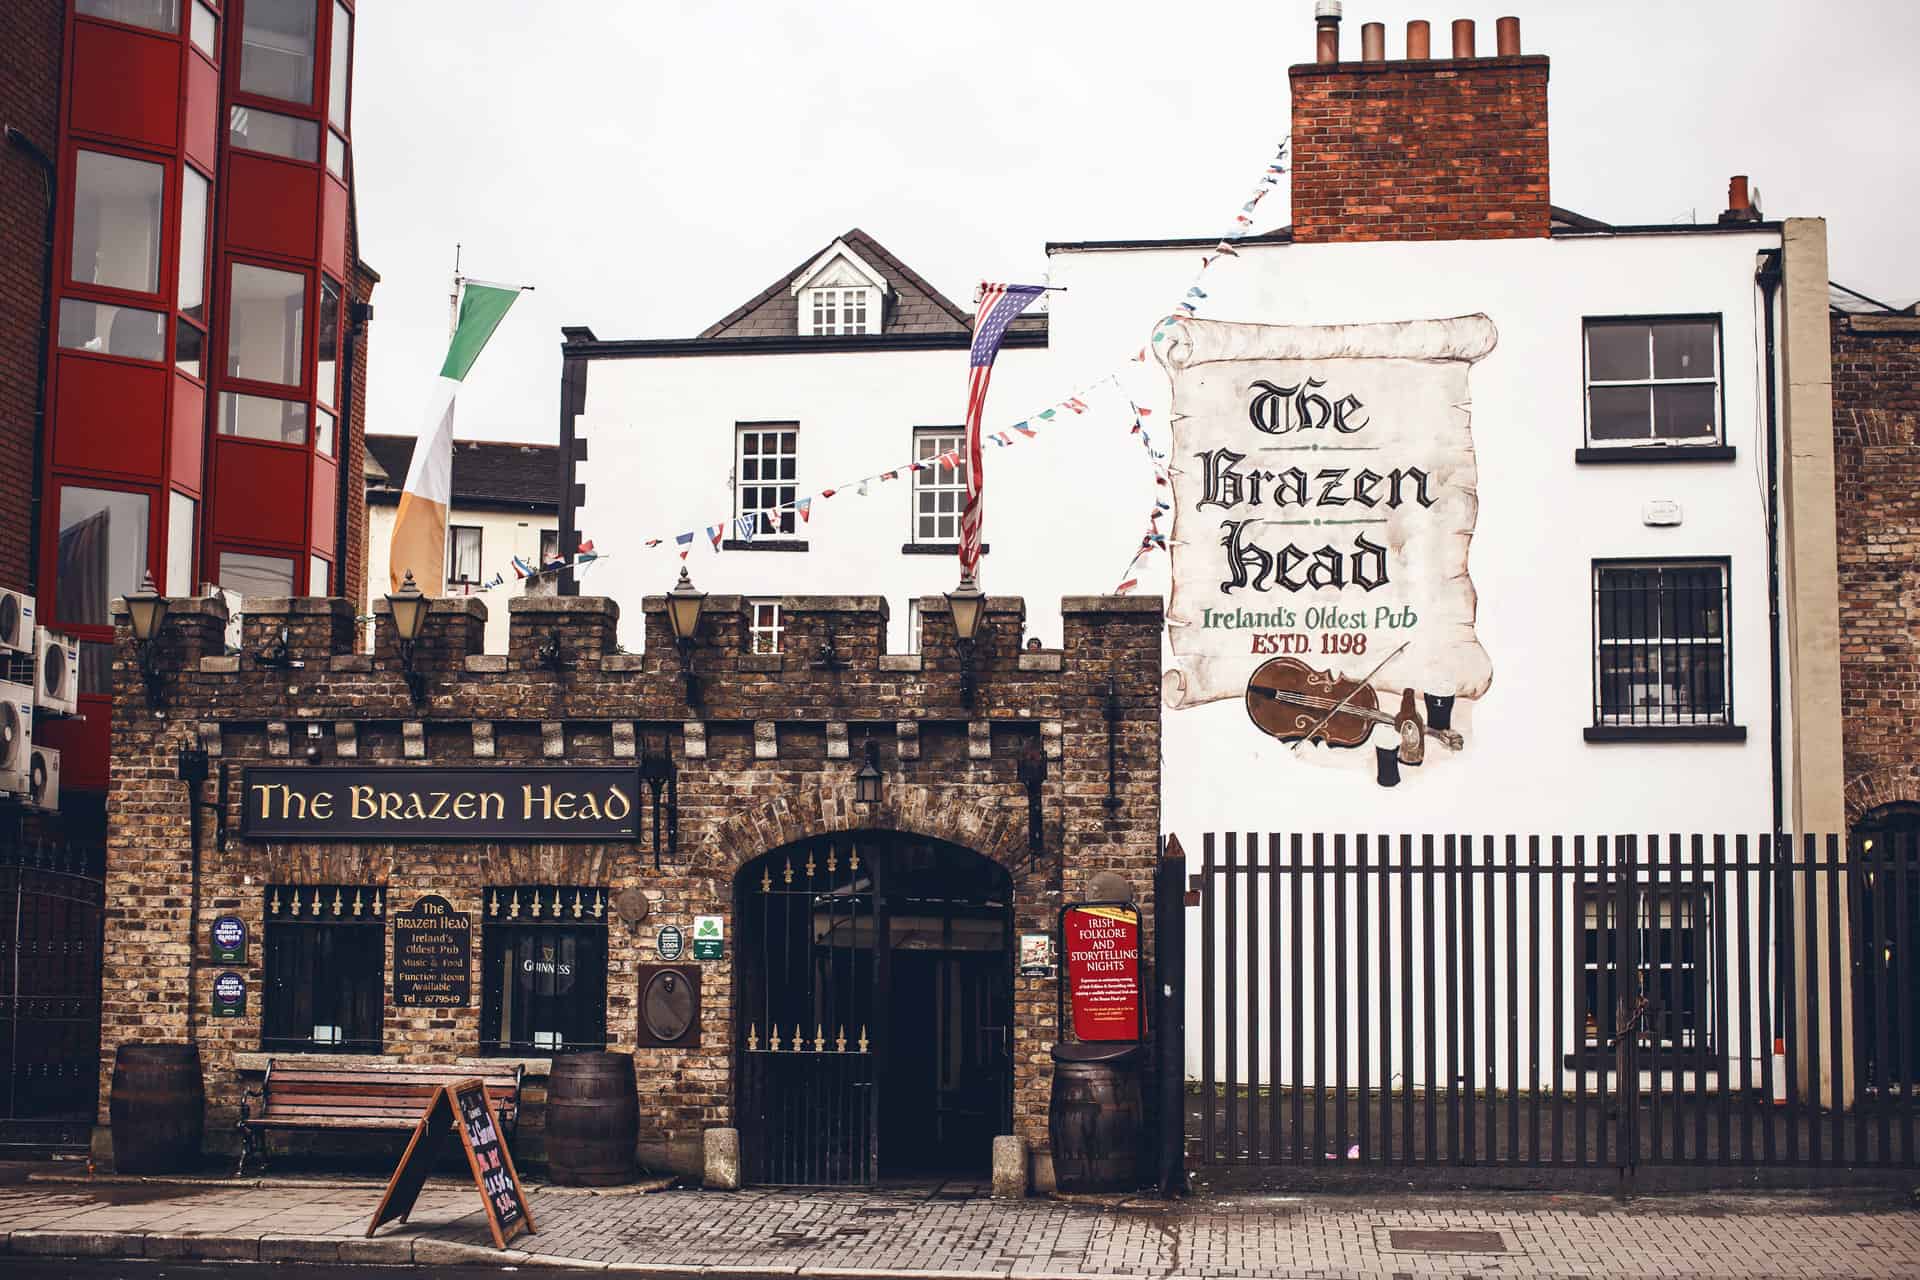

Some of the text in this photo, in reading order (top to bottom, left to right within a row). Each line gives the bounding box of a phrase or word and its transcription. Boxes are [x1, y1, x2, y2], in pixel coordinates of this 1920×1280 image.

[1247, 376, 1370, 435] The
[1194, 446, 1440, 513] Brazen
[1203, 606, 1418, 629] Ireland's Oldest Pub
[1251, 633, 1368, 656] ESTD. 1198
[251, 783, 334, 820] The
[423, 903, 445, 915] The
[1089, 918, 1115, 929] IRISH
[412, 933, 454, 944] Ireland's
[1079, 928, 1127, 940] FOLKLORE
[440, 944, 459, 954] Pub
[1092, 940, 1115, 950] AND
[1071, 949, 1138, 961] STORYTELLING
[1087, 960, 1125, 972] NIGHTS
